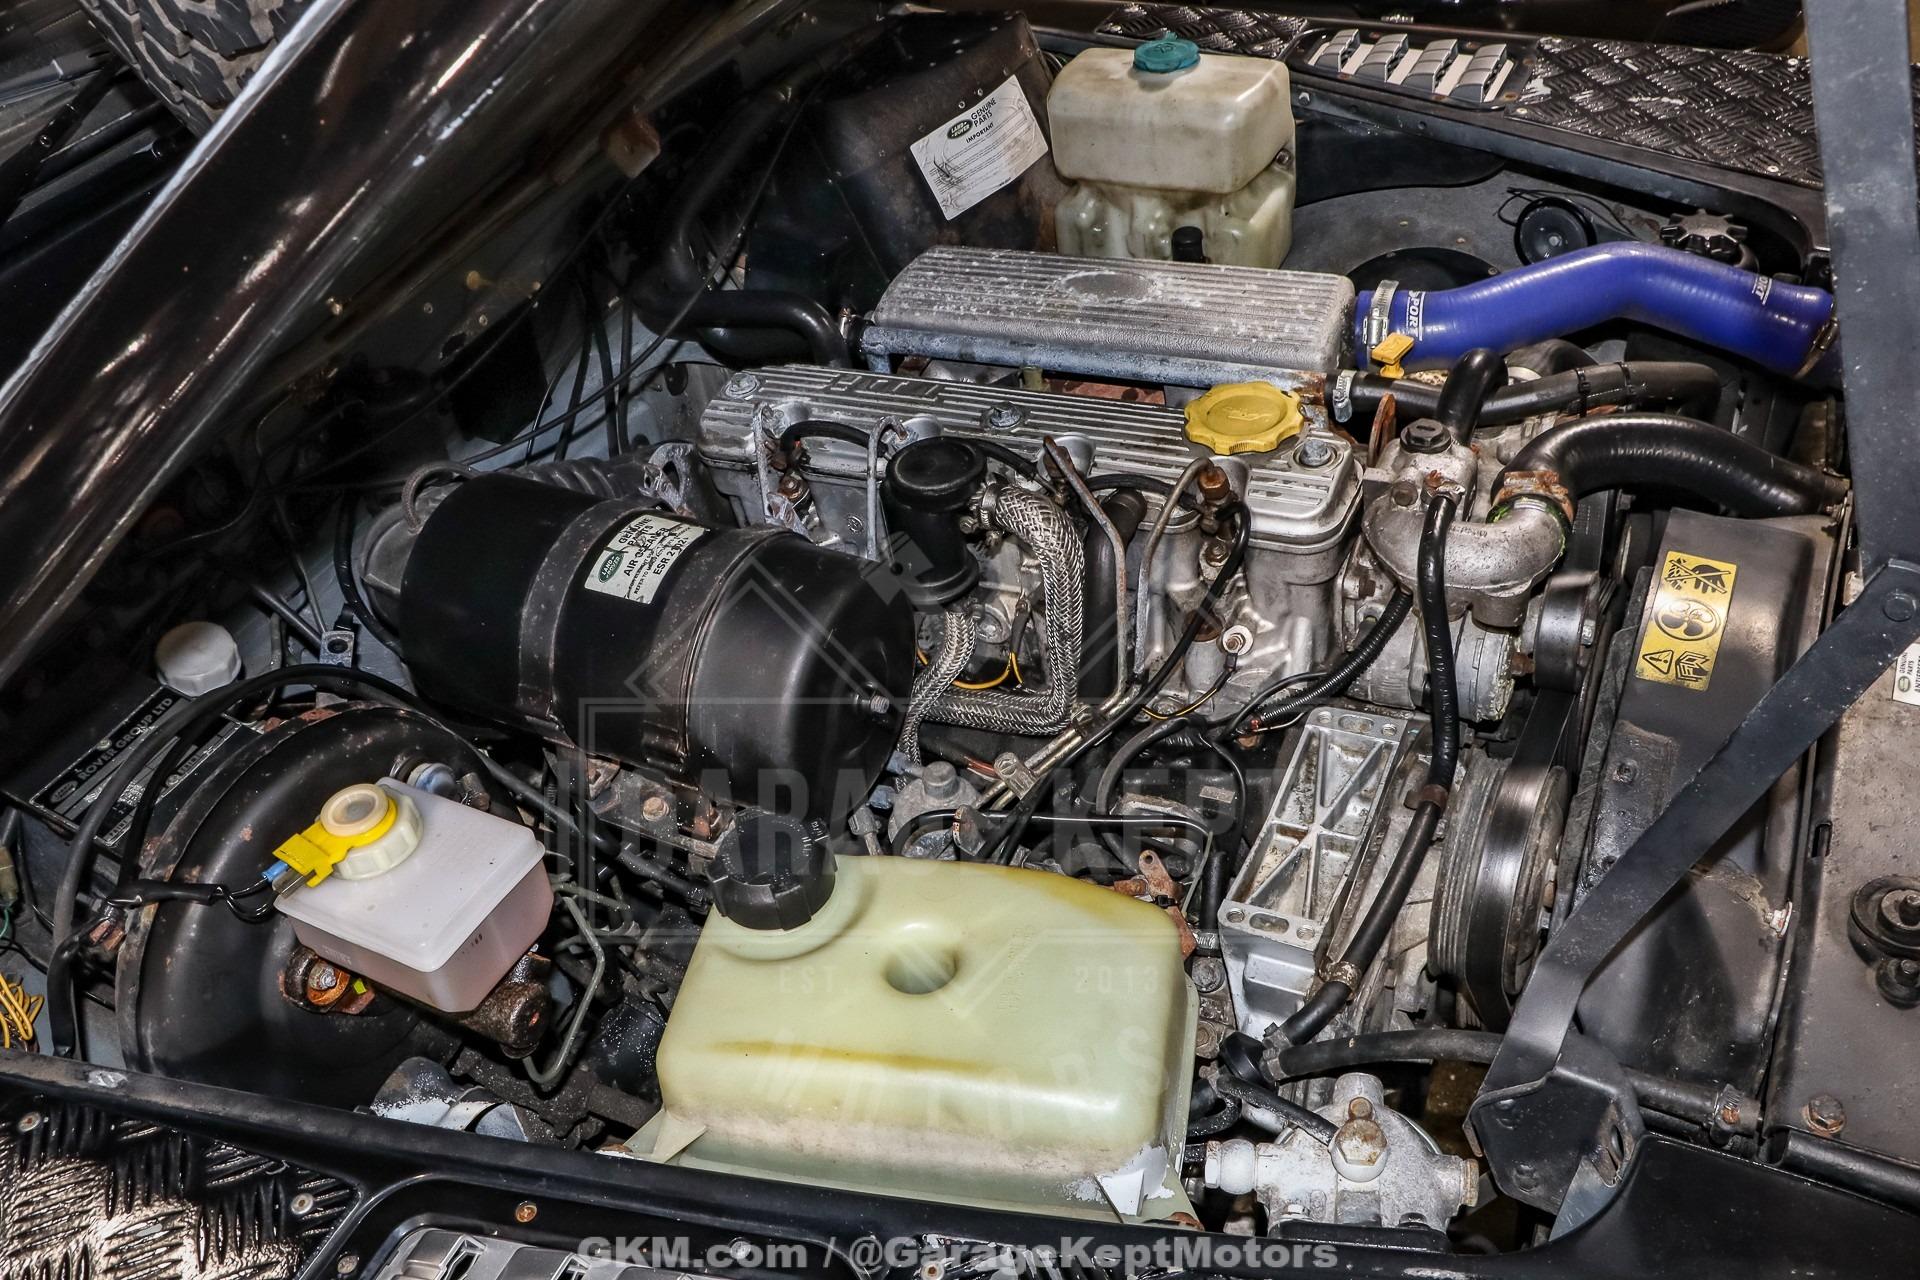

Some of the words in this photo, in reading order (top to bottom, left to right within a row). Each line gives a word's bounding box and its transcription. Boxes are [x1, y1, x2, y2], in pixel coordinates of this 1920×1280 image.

[970, 97, 997, 120] GENUINE
[973, 111, 993, 128] PARTS
[965, 122, 994, 144] IMPORTANT
[623, 557, 639, 577] AIR
[653, 557, 671, 575] ESR
[79, 747, 118, 781] ROVER
[115, 715, 155, 749] GROUP
[151, 697, 173, 717] LTD
